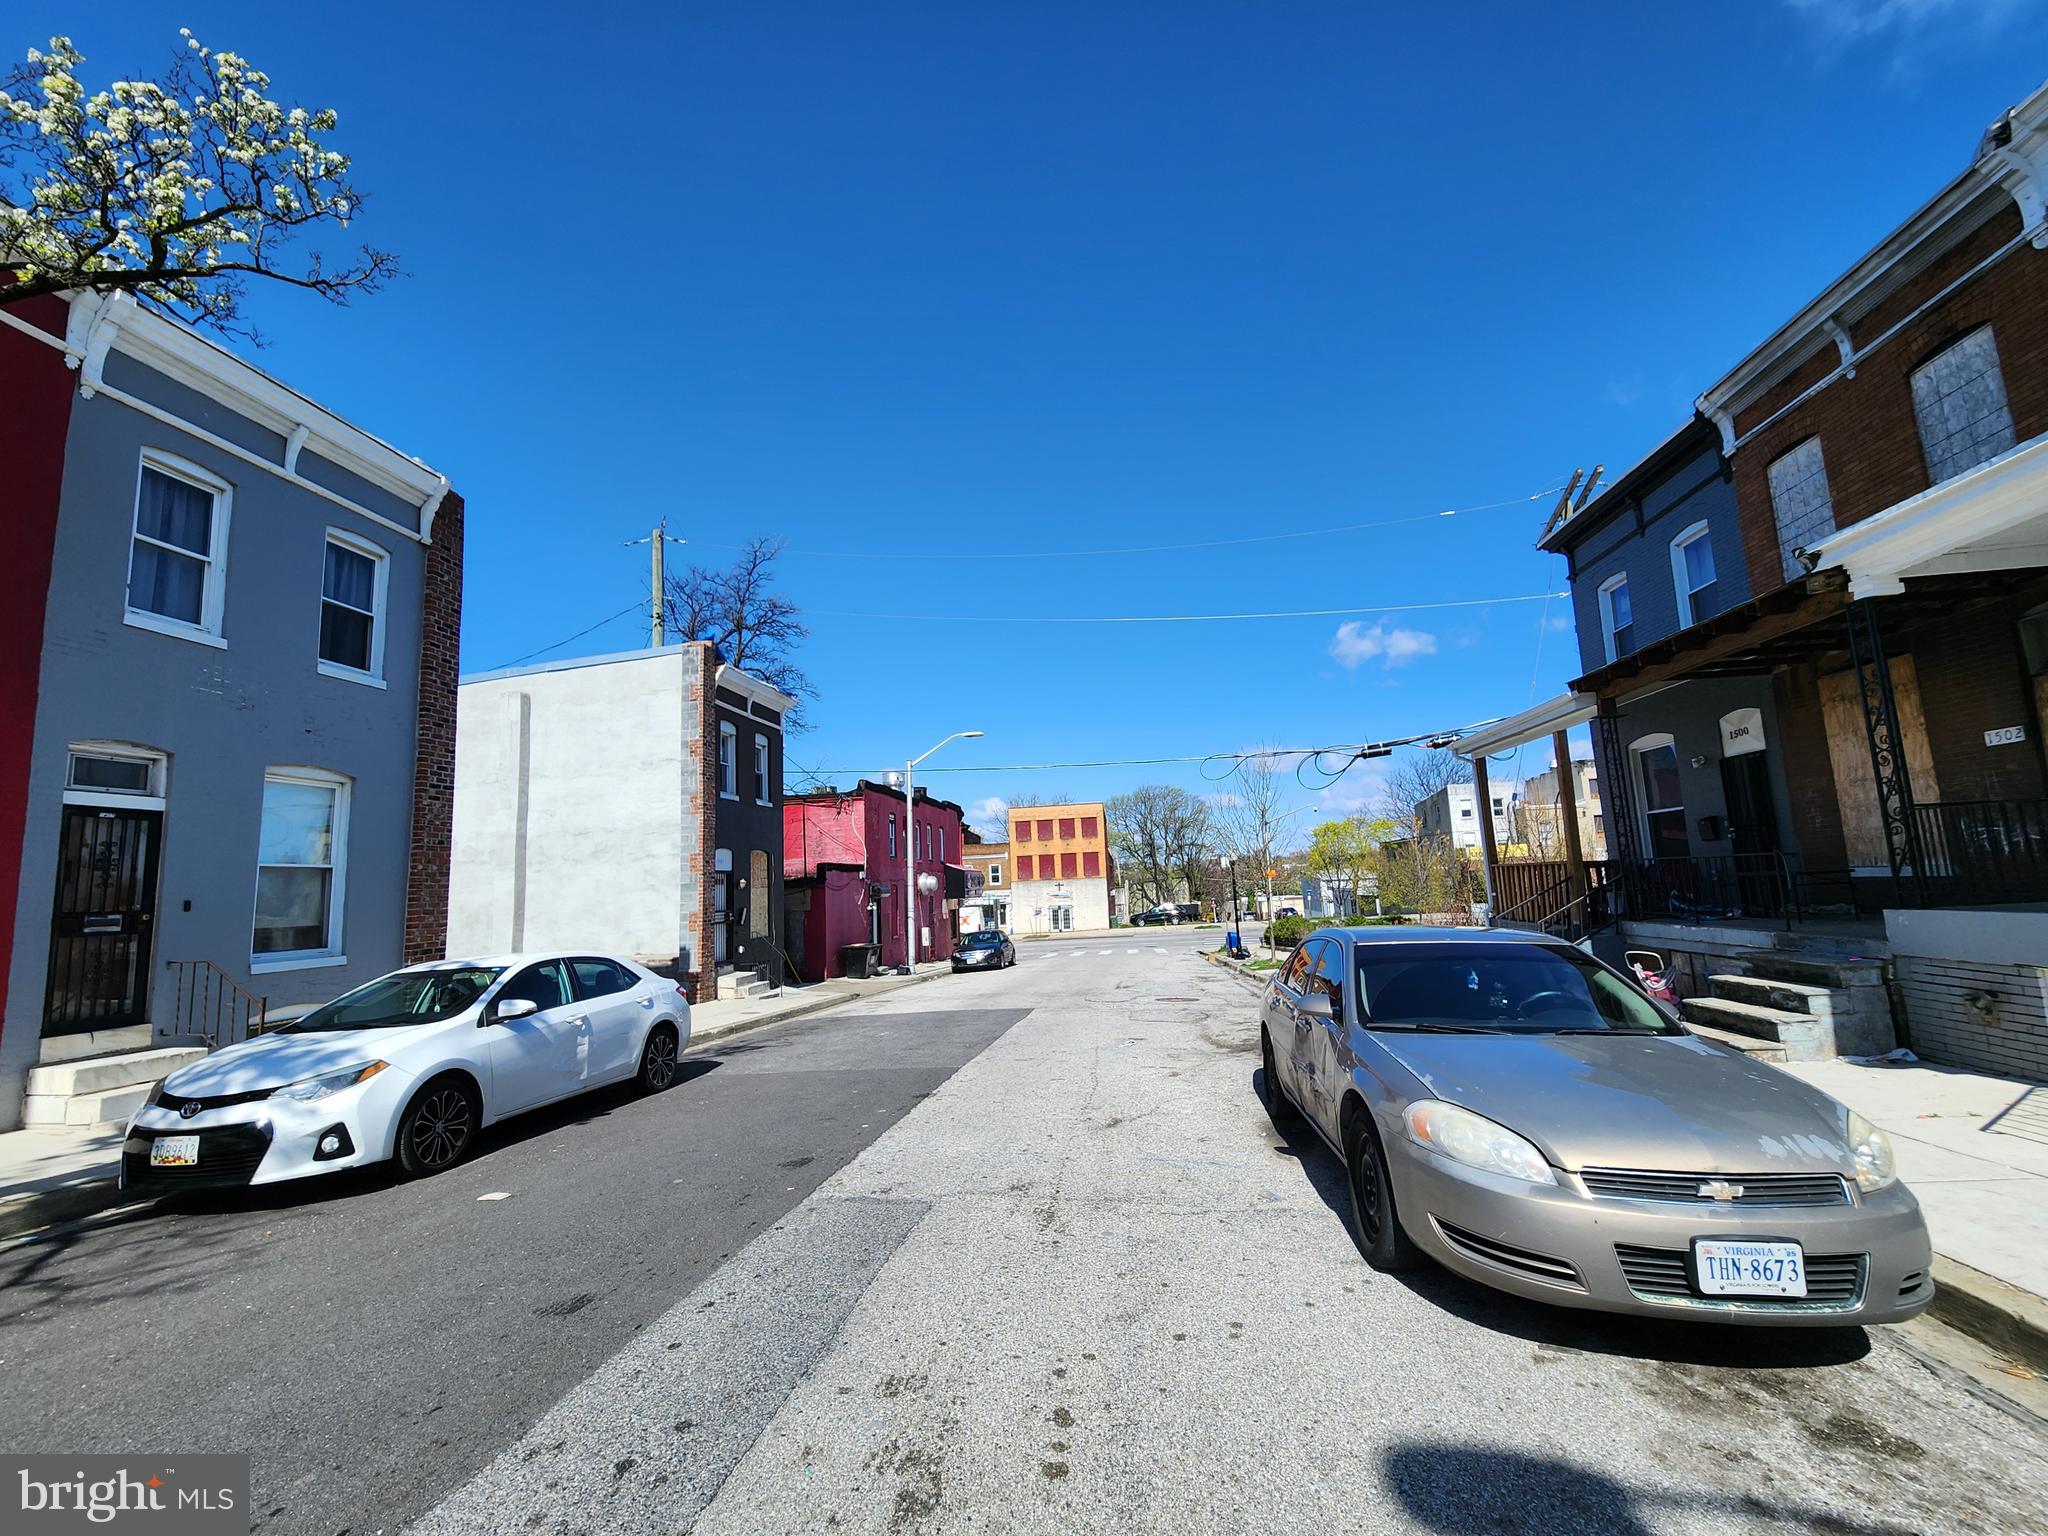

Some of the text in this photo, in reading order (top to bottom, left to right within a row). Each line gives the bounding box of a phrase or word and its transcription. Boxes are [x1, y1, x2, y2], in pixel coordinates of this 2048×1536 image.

[1729, 726, 1749, 740] 1500
[1986, 728, 2022, 745] 1502
[1723, 1246, 1774, 1257] VIRGINIA
[1705, 1256, 1799, 1282] THN-8673
